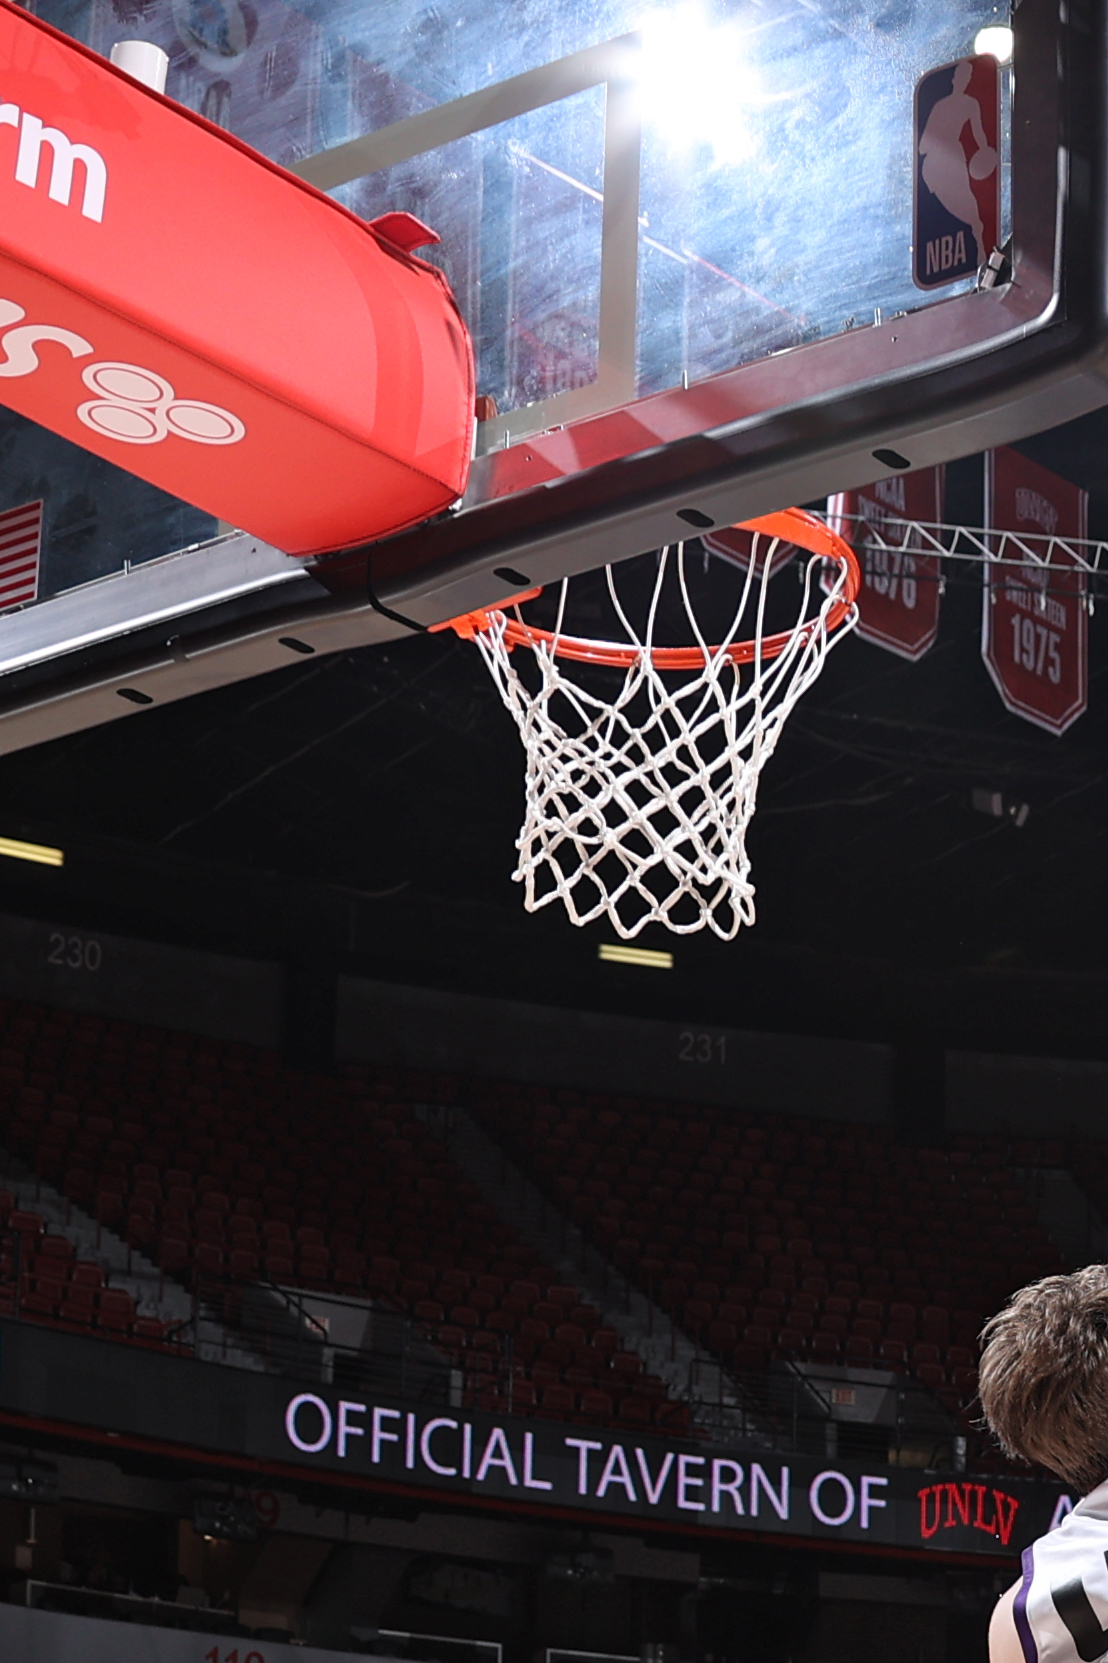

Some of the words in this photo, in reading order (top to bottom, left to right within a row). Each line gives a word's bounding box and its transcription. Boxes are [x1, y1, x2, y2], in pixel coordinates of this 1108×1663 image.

[926, 230, 967, 275] NBA
[1010, 612, 1062, 684] 1975
[47, 932, 103, 972] 230
[678, 1031, 726, 1065] 231
[285, 1393, 554, 1491] OFFICIAL
[564, 1437, 790, 1521] TAVERN
[808, 1470, 889, 1530] OF
[917, 1482, 1020, 1546] UNLV
